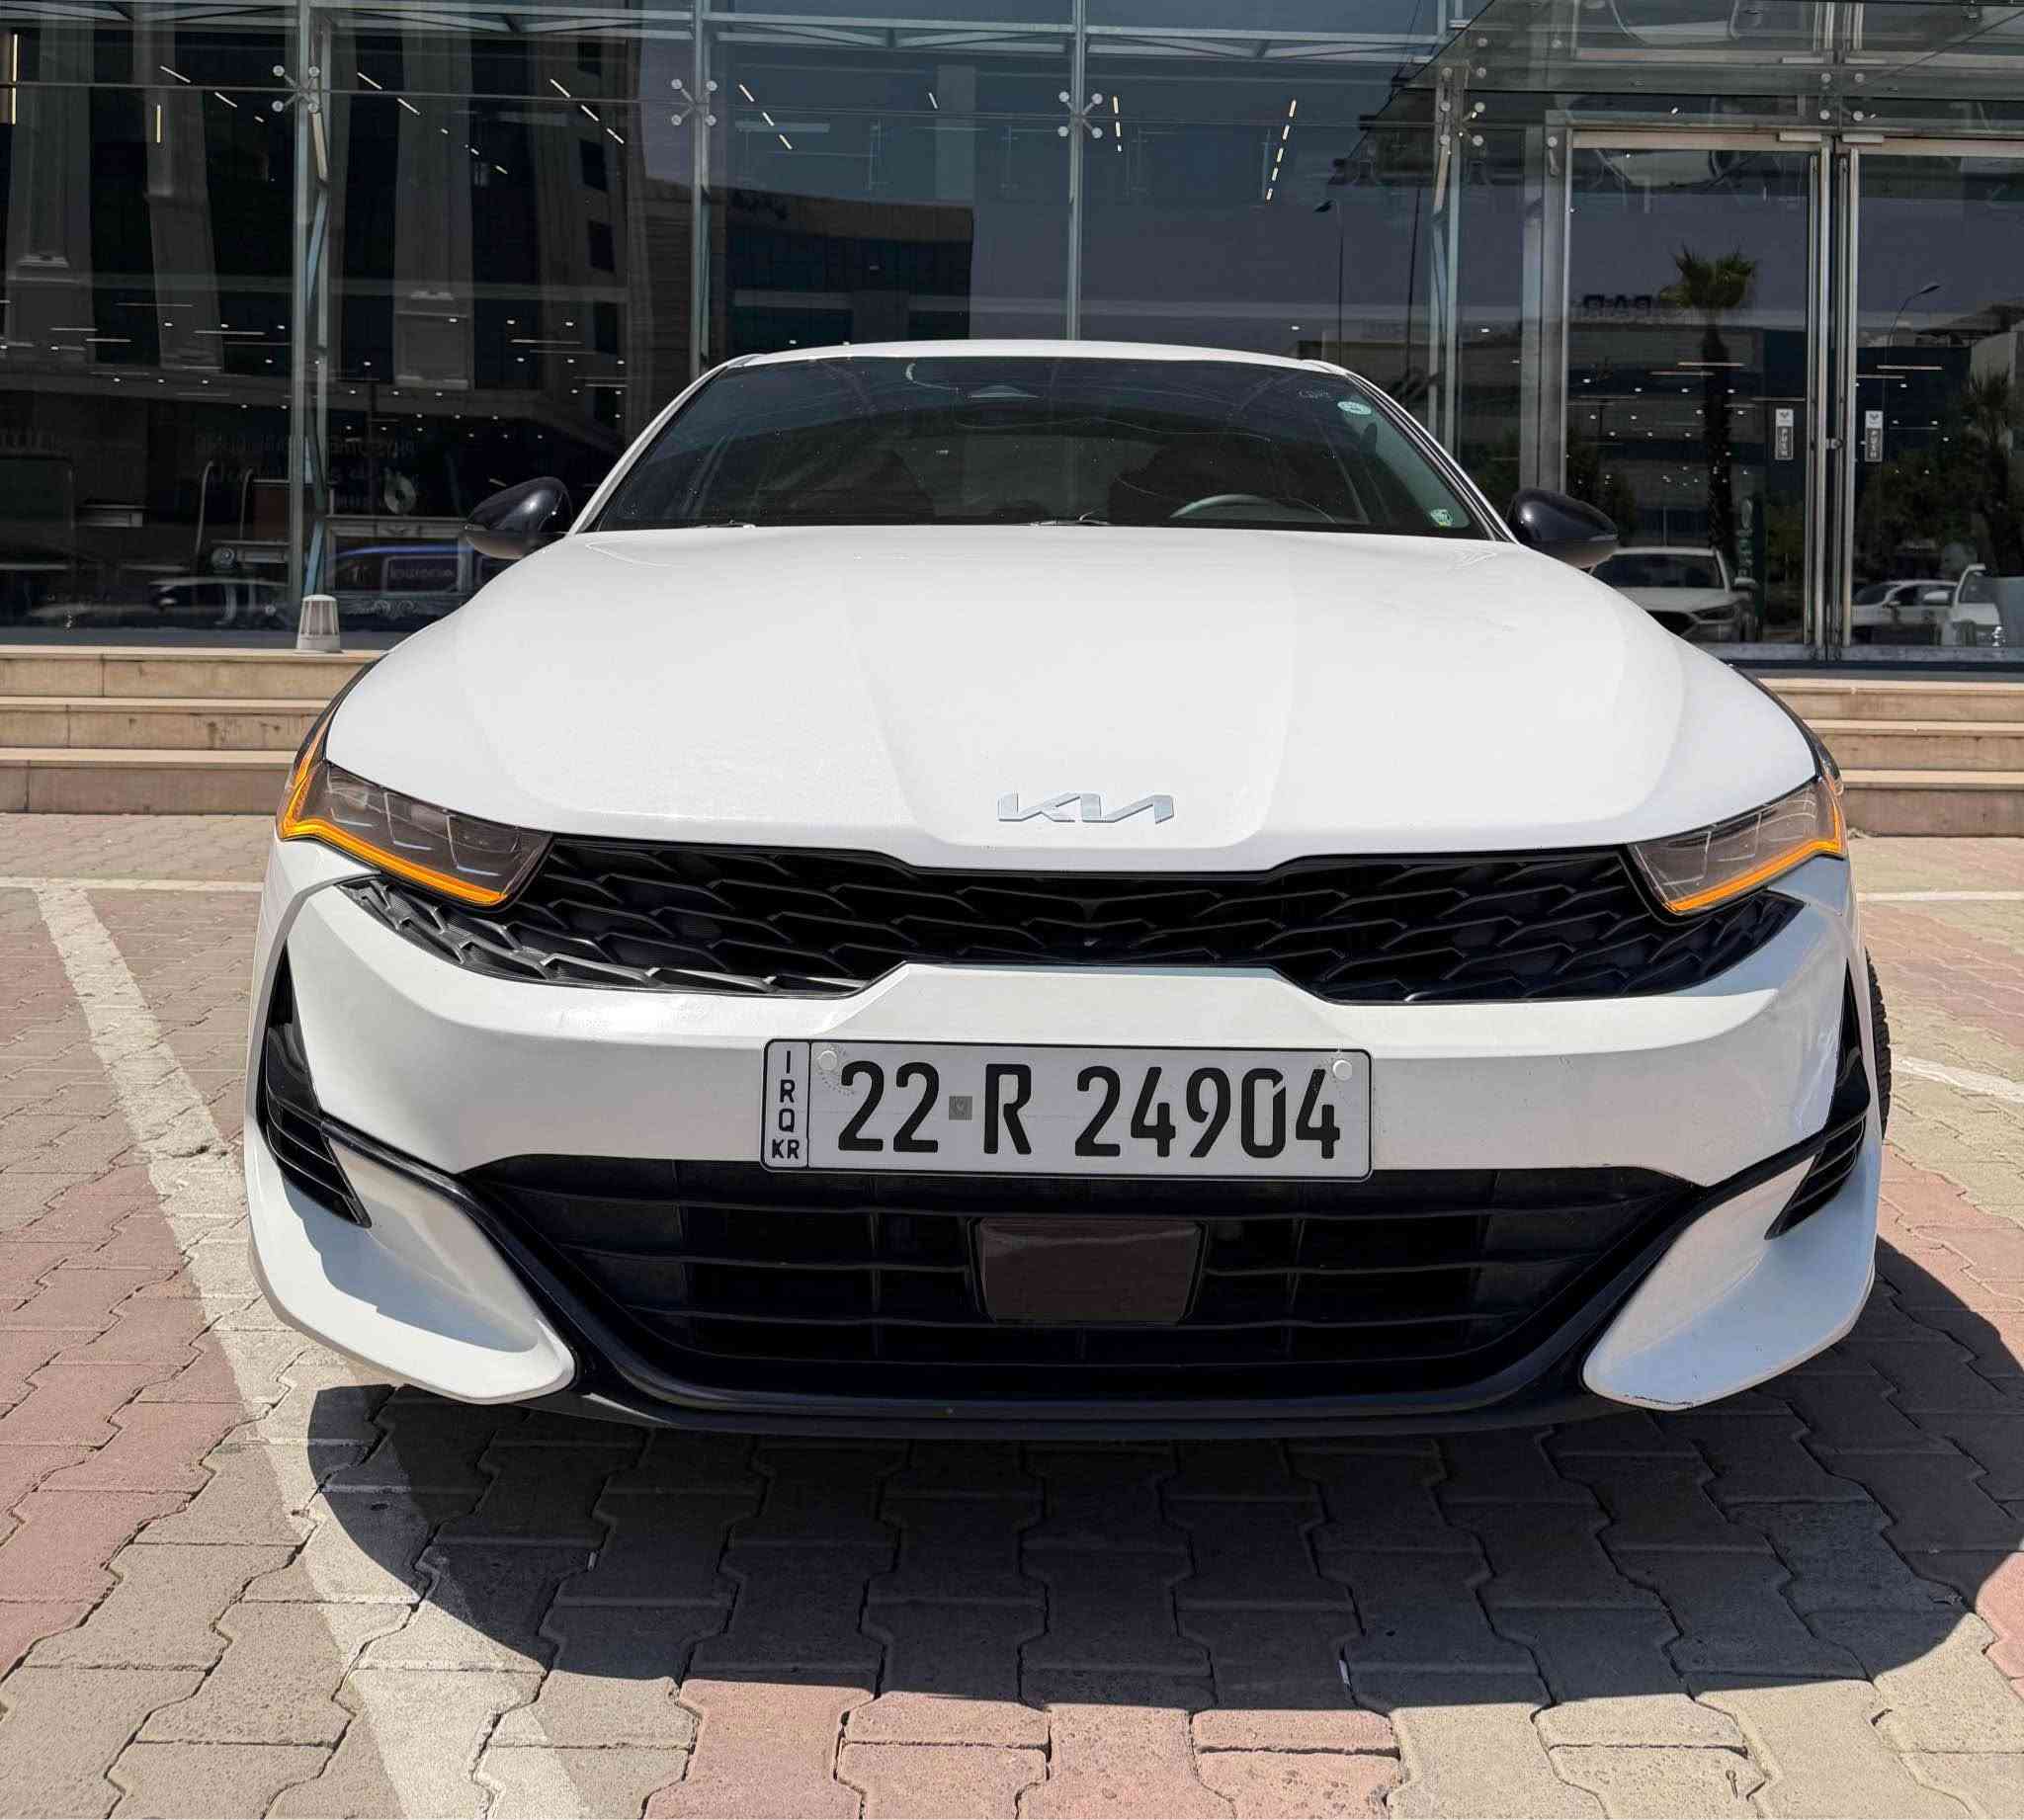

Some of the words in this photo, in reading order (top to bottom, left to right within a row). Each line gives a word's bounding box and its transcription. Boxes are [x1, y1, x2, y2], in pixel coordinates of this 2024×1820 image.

[998, 792, 1174, 824] KIA
[838, 1060, 940, 1153] 22
[983, 1063, 1032, 1155] R
[1074, 1065, 1341, 1159] 24904
[772, 1138, 800, 1159] KR
